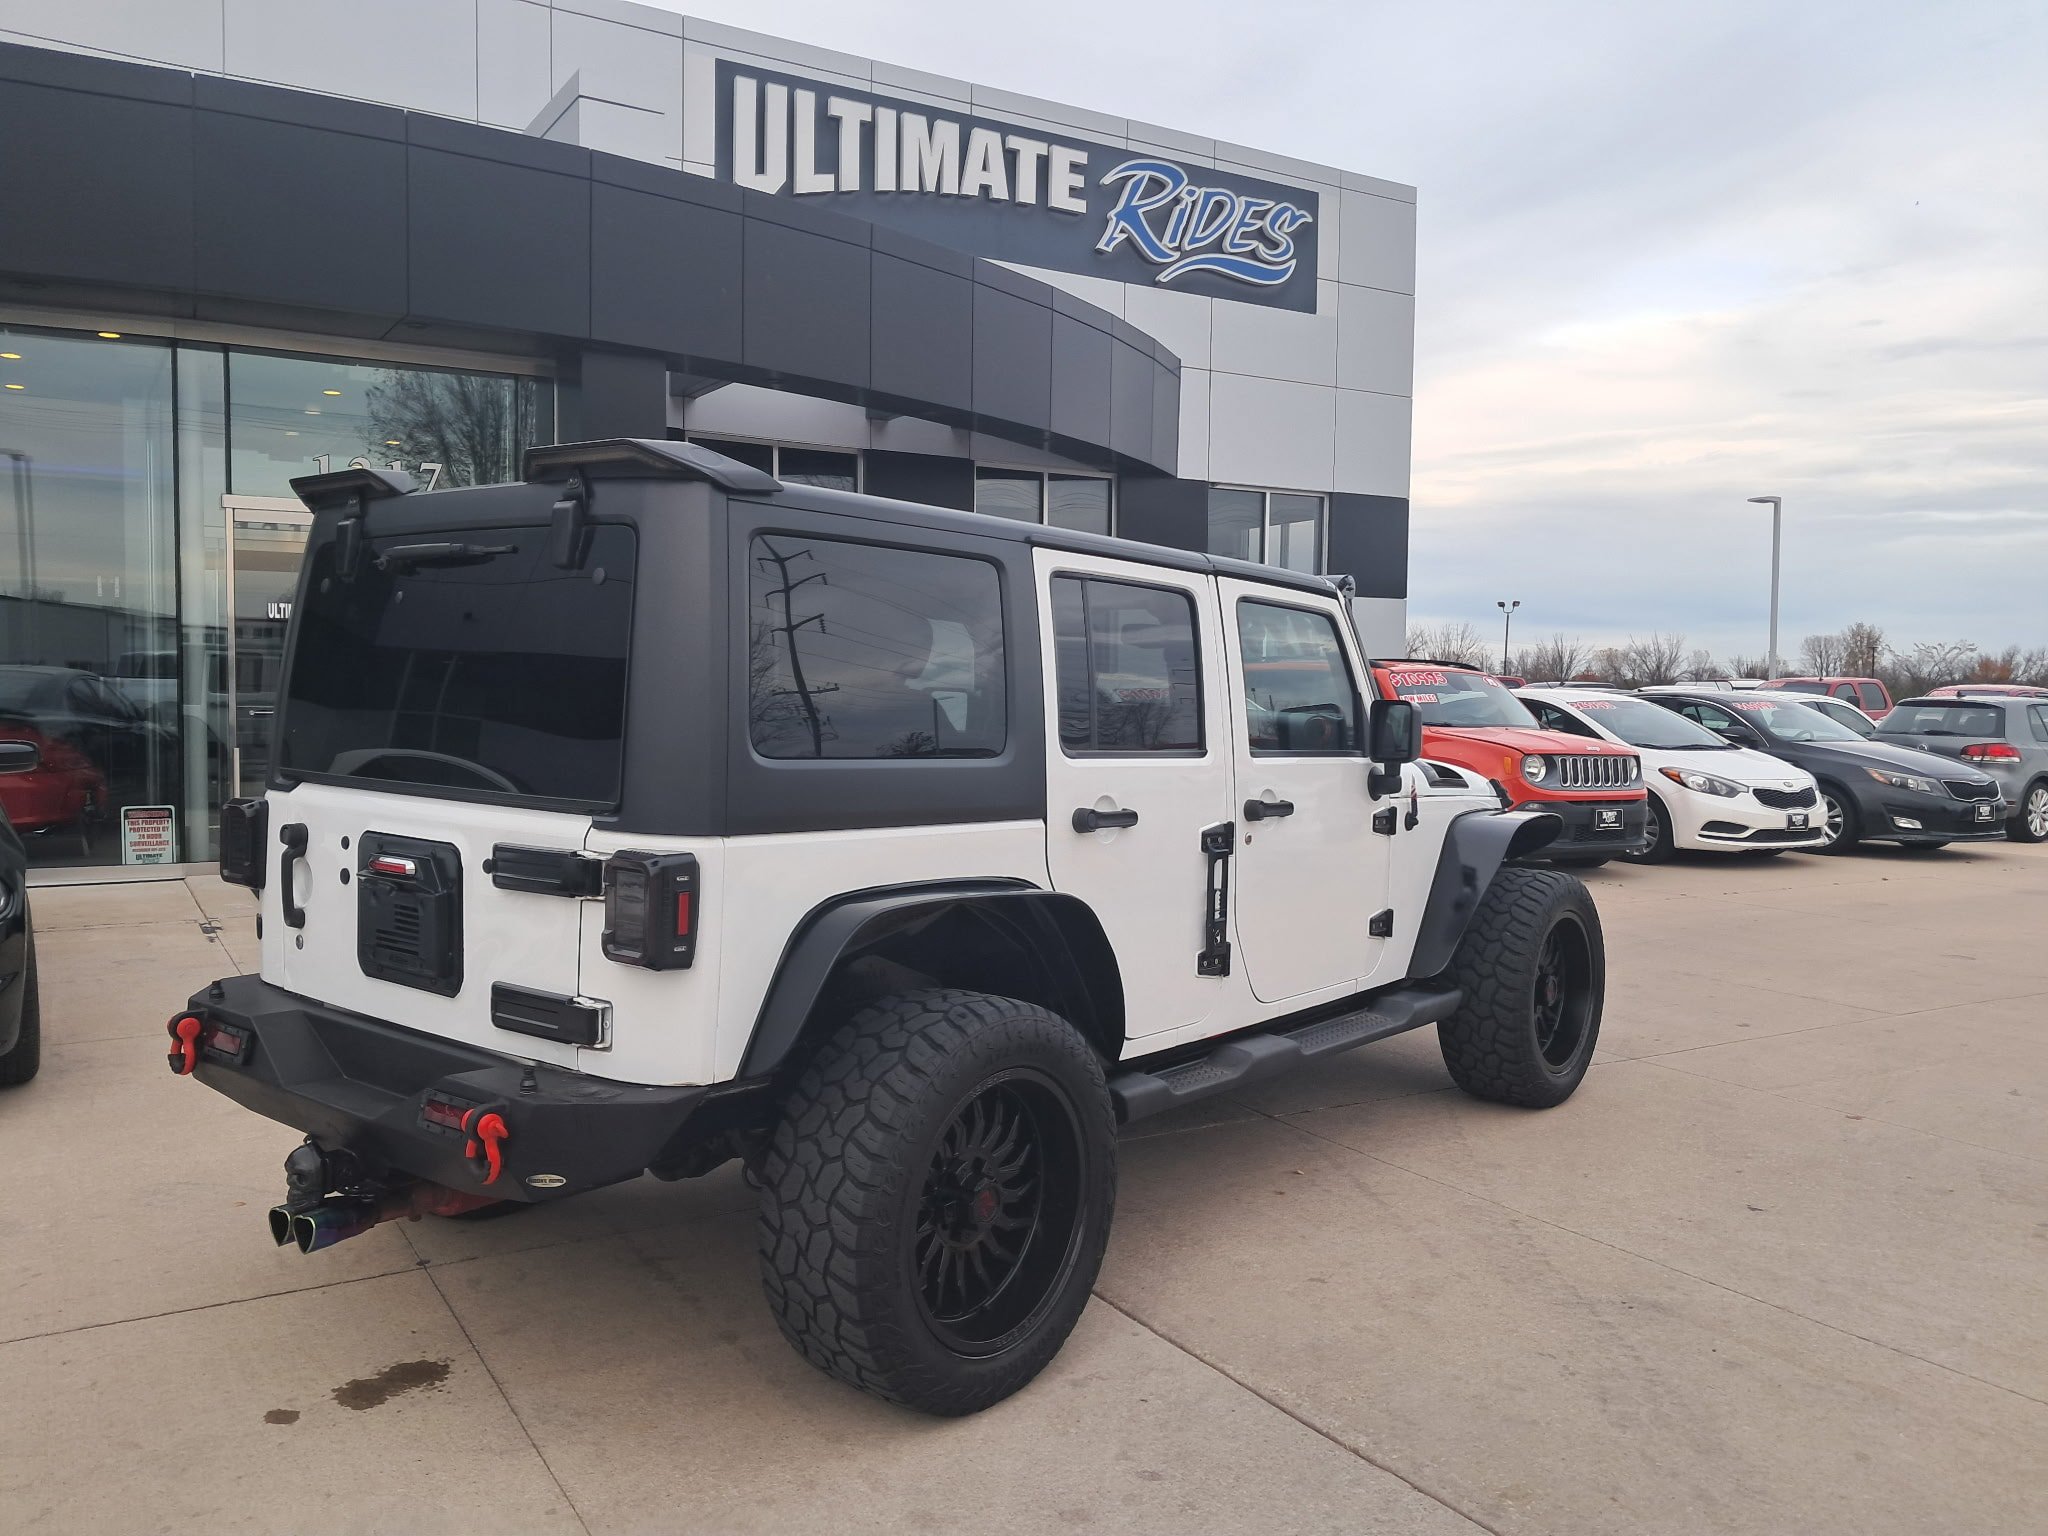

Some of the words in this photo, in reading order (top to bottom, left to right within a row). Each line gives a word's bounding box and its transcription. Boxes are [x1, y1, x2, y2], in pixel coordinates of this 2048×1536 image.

[733, 75, 1089, 214] ULTIMATE
[1390, 671, 1448, 687] $10995
[1417, 694, 1437, 703] MILES
